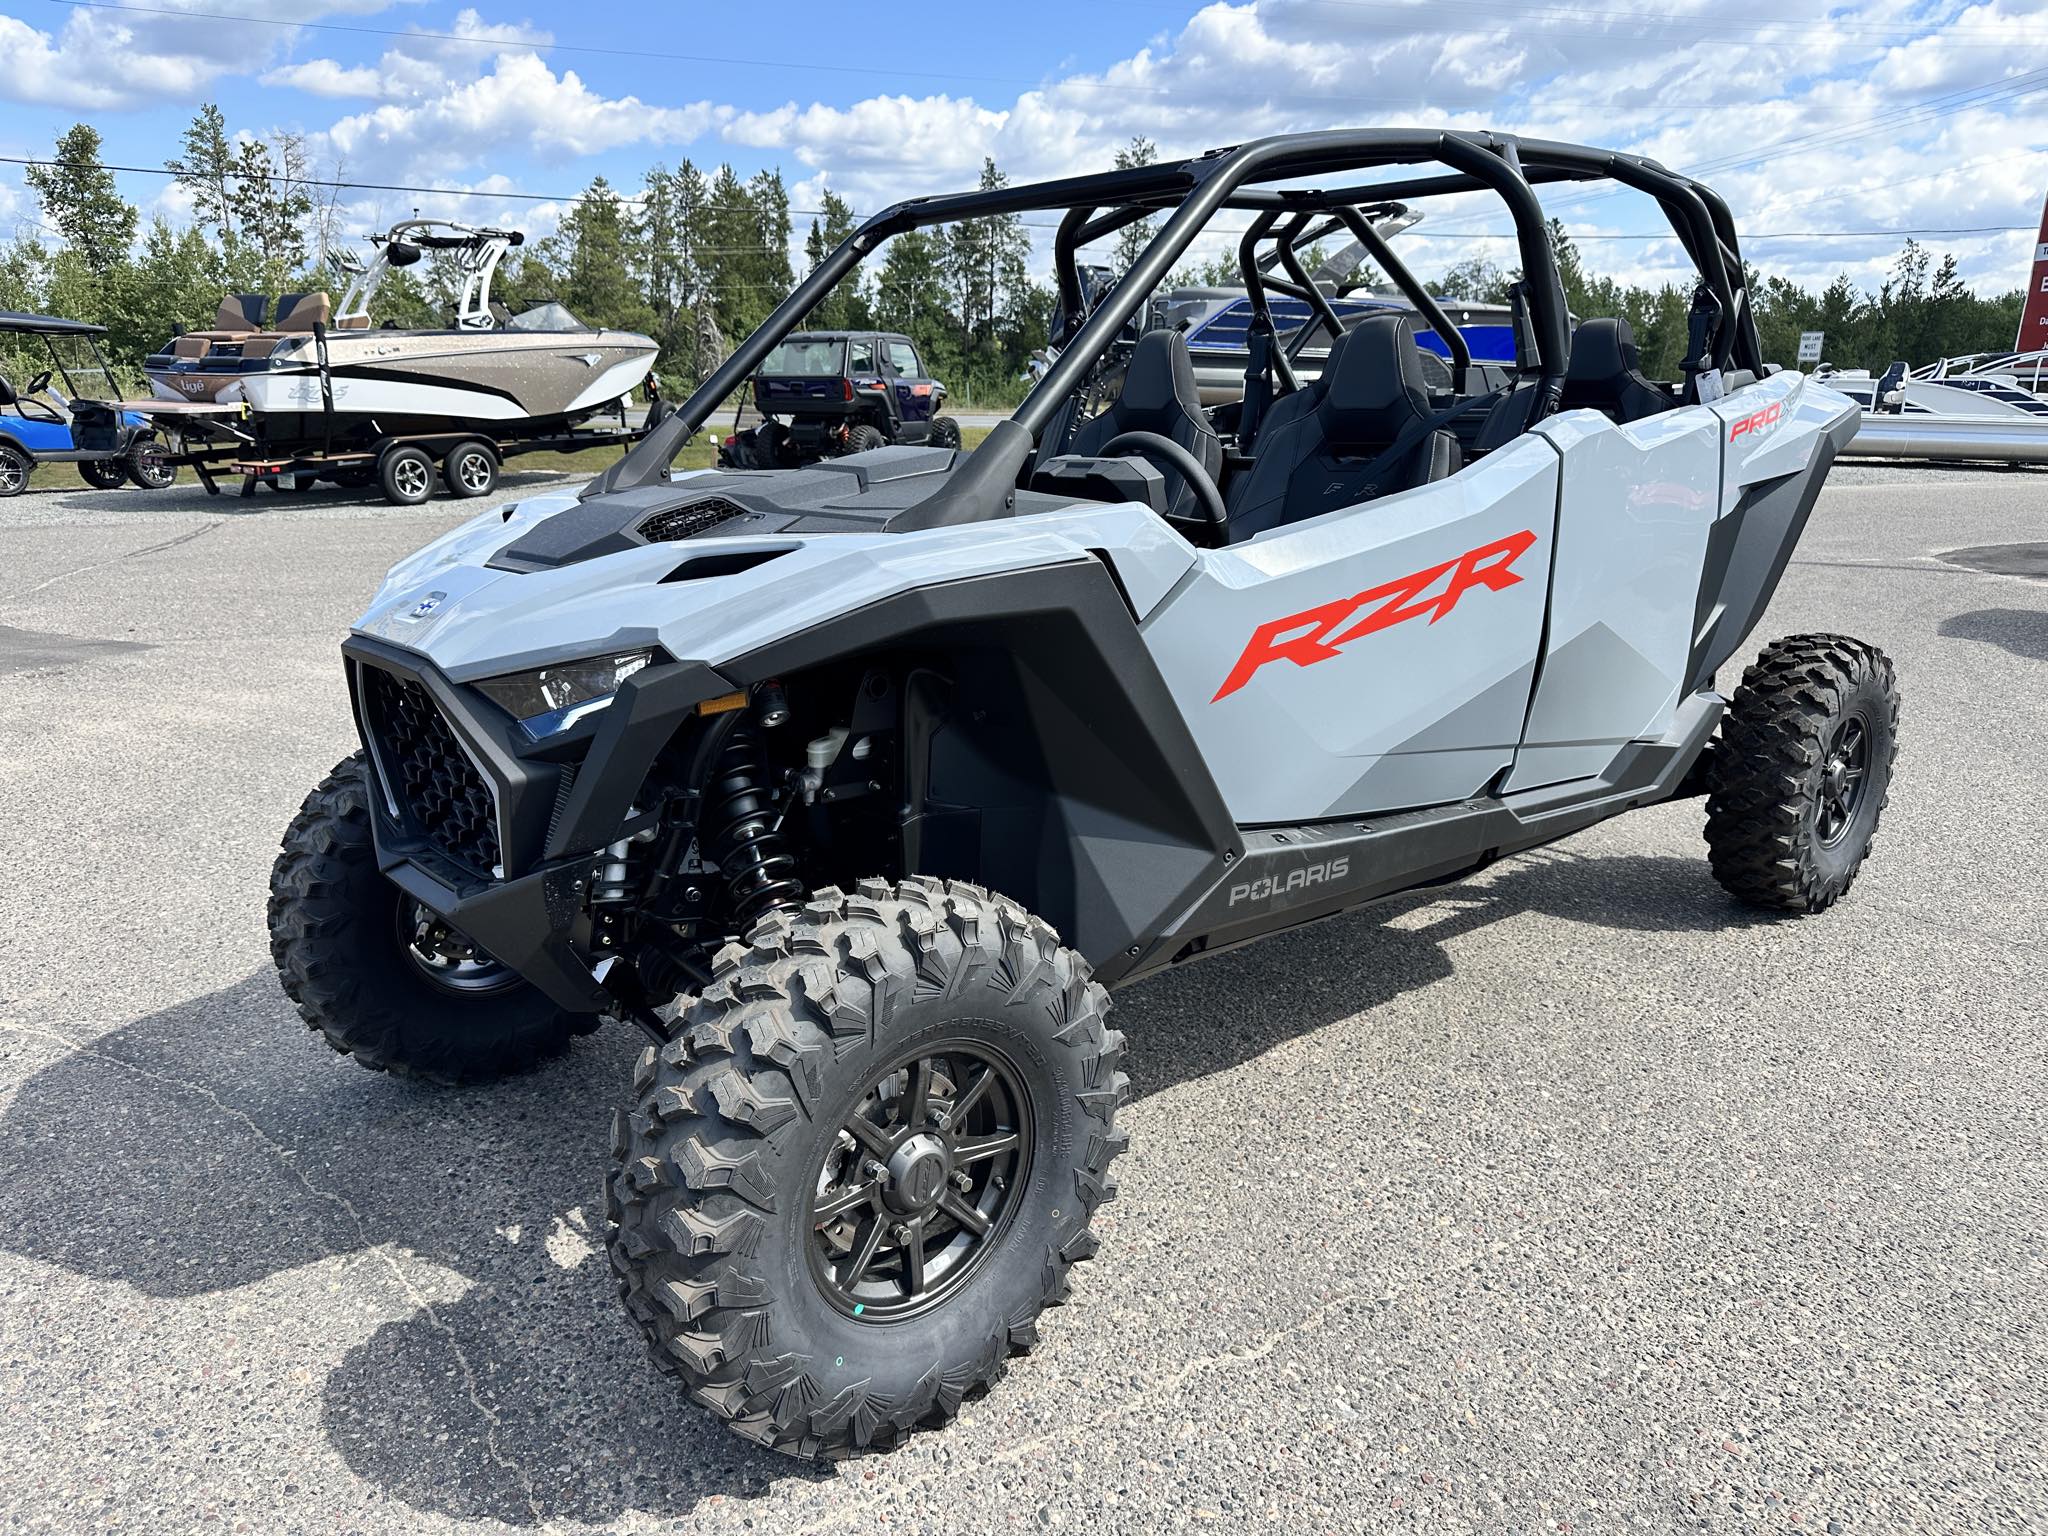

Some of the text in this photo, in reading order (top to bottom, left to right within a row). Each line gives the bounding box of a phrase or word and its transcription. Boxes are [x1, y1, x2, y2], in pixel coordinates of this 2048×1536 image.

[1729, 400, 1781, 443] PRO
[1209, 529, 1538, 705] RZR
[1228, 857, 1349, 907] POLARIS
